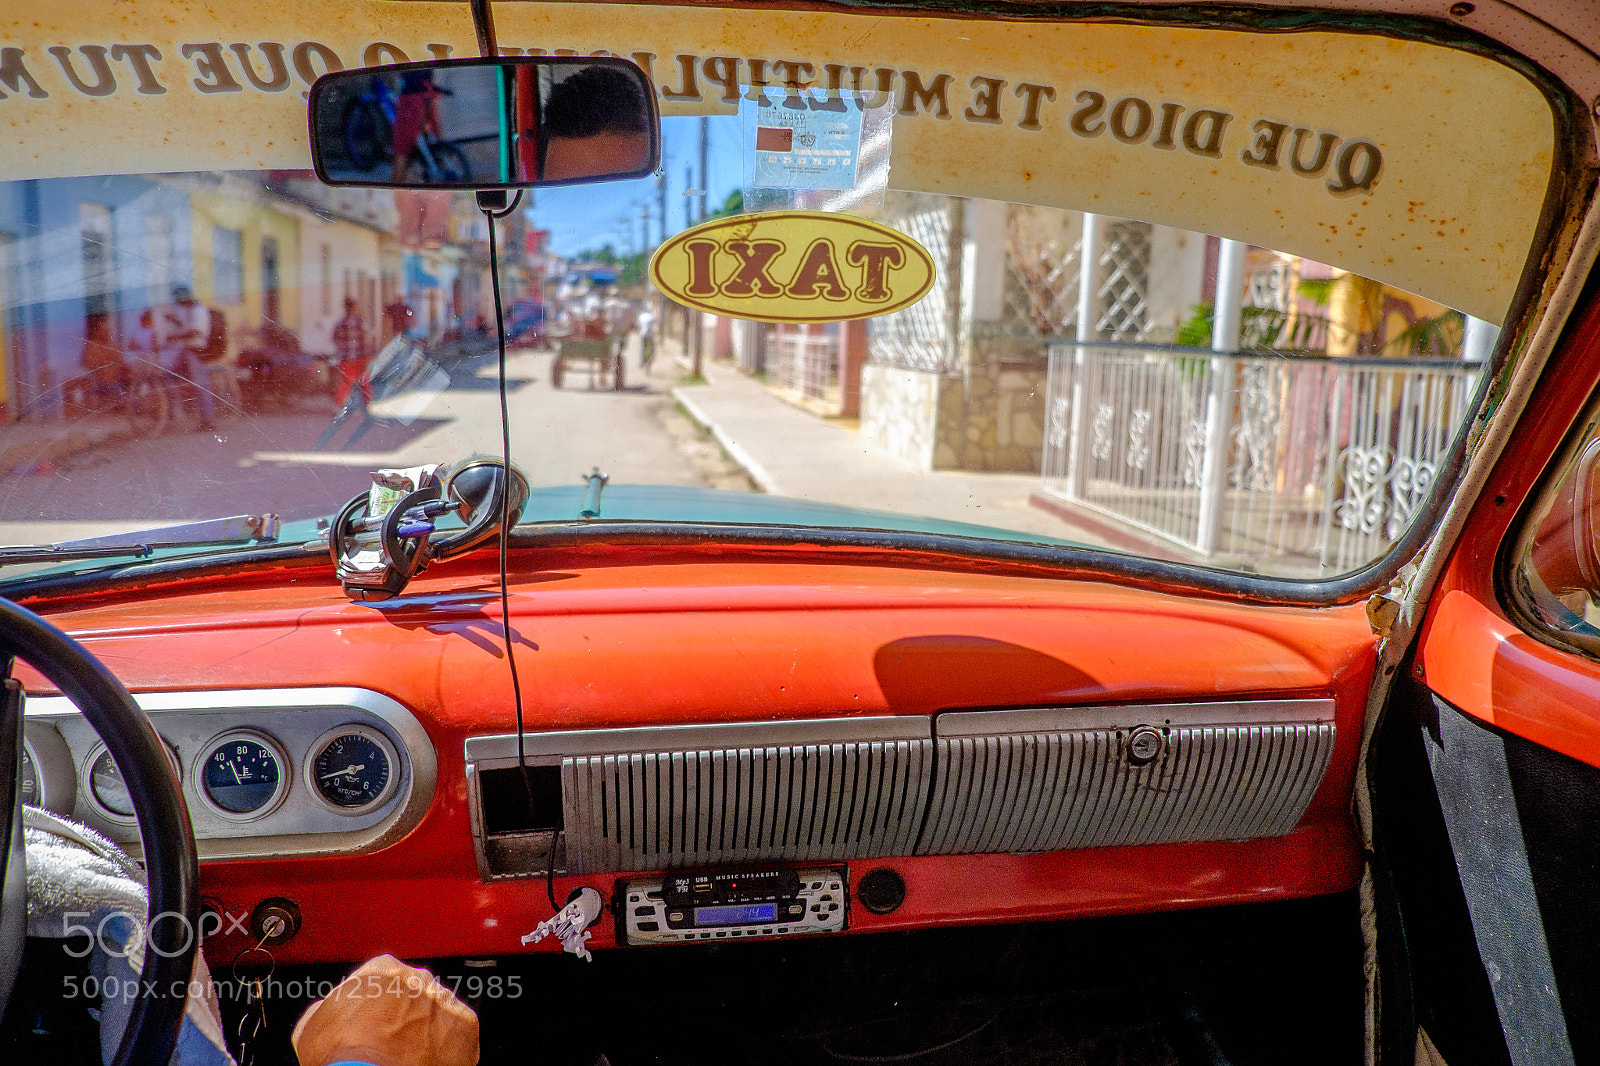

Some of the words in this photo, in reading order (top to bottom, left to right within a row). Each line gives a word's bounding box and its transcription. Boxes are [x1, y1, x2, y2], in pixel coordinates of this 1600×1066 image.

[236, 745, 248, 755] 80
[336, 745, 344, 754] 2
[214, 752, 225, 762] 40
[369, 752, 375, 760] 4
[333, 777, 340, 787] 0
[363, 781, 370, 790] 6
